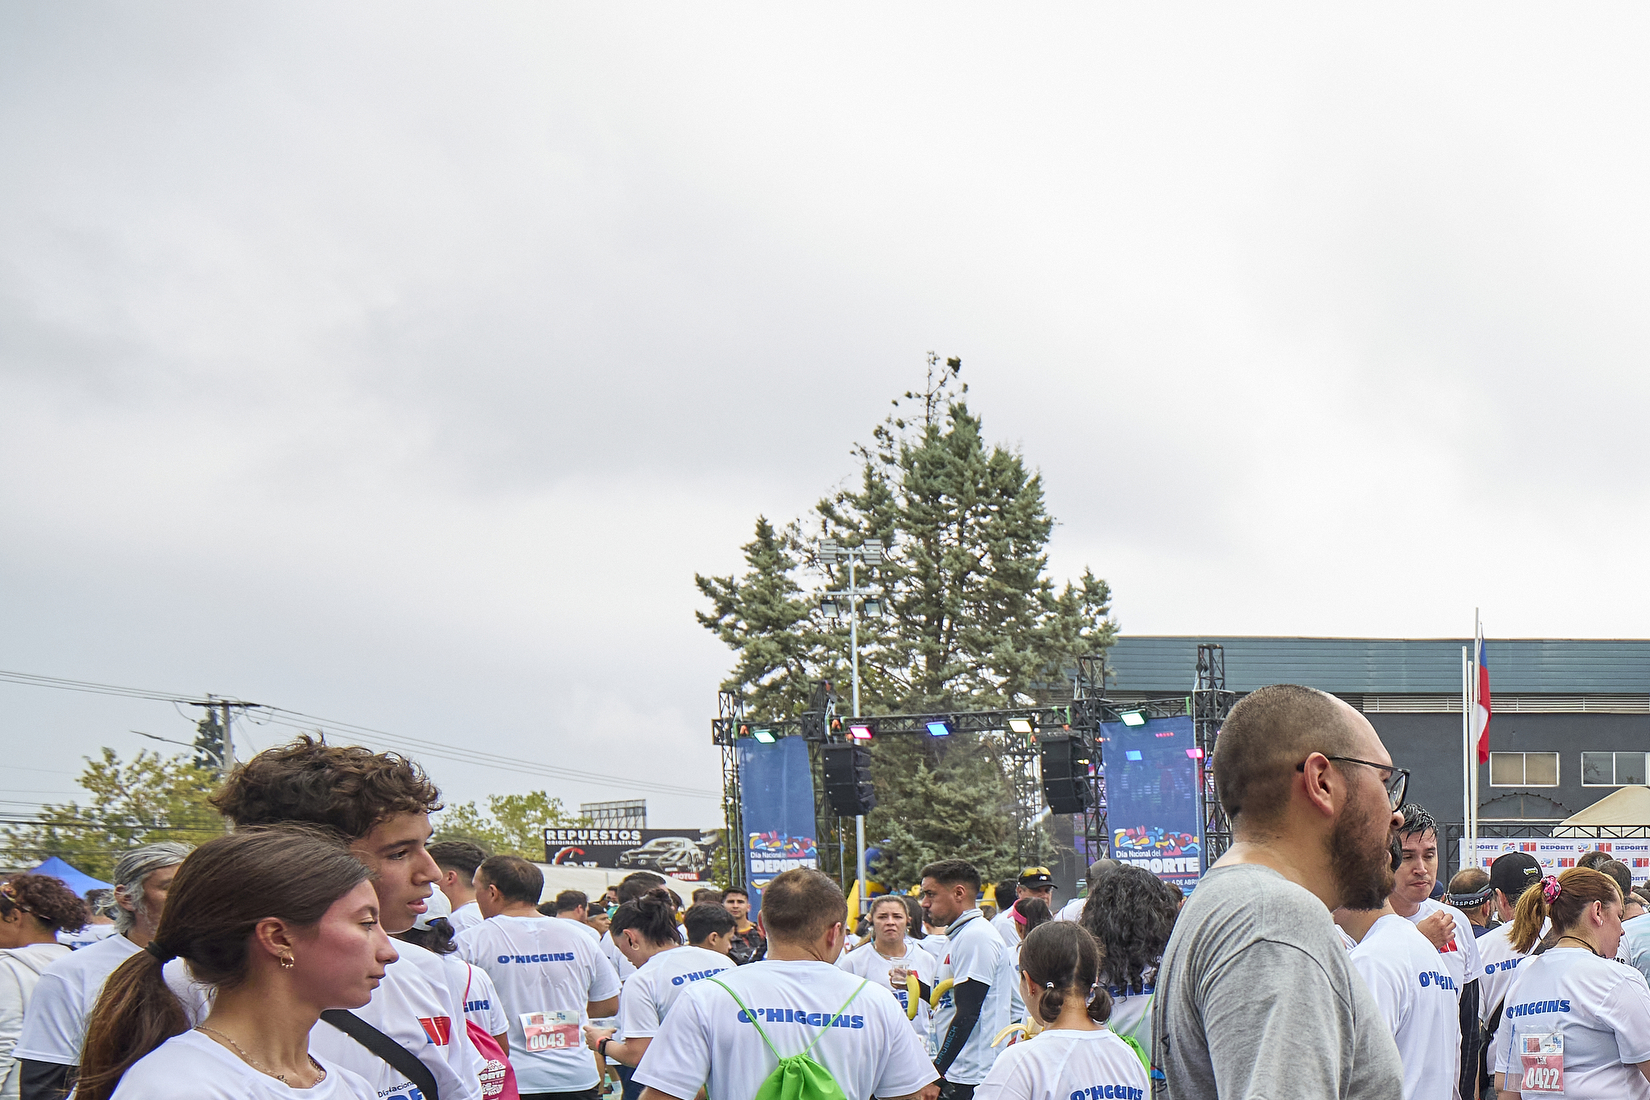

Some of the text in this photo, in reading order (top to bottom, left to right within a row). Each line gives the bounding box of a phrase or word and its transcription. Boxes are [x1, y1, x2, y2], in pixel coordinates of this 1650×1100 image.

[546, 830, 642, 841] REPUESTOS
[497, 952, 575, 964] O'HIGGINS
[737, 1008, 864, 1029] O'HIGGINS
[1506, 999, 1571, 1019] O'HIGGINS
[530, 1032, 566, 1050] 0043
[1525, 1067, 1560, 1090] 0422
